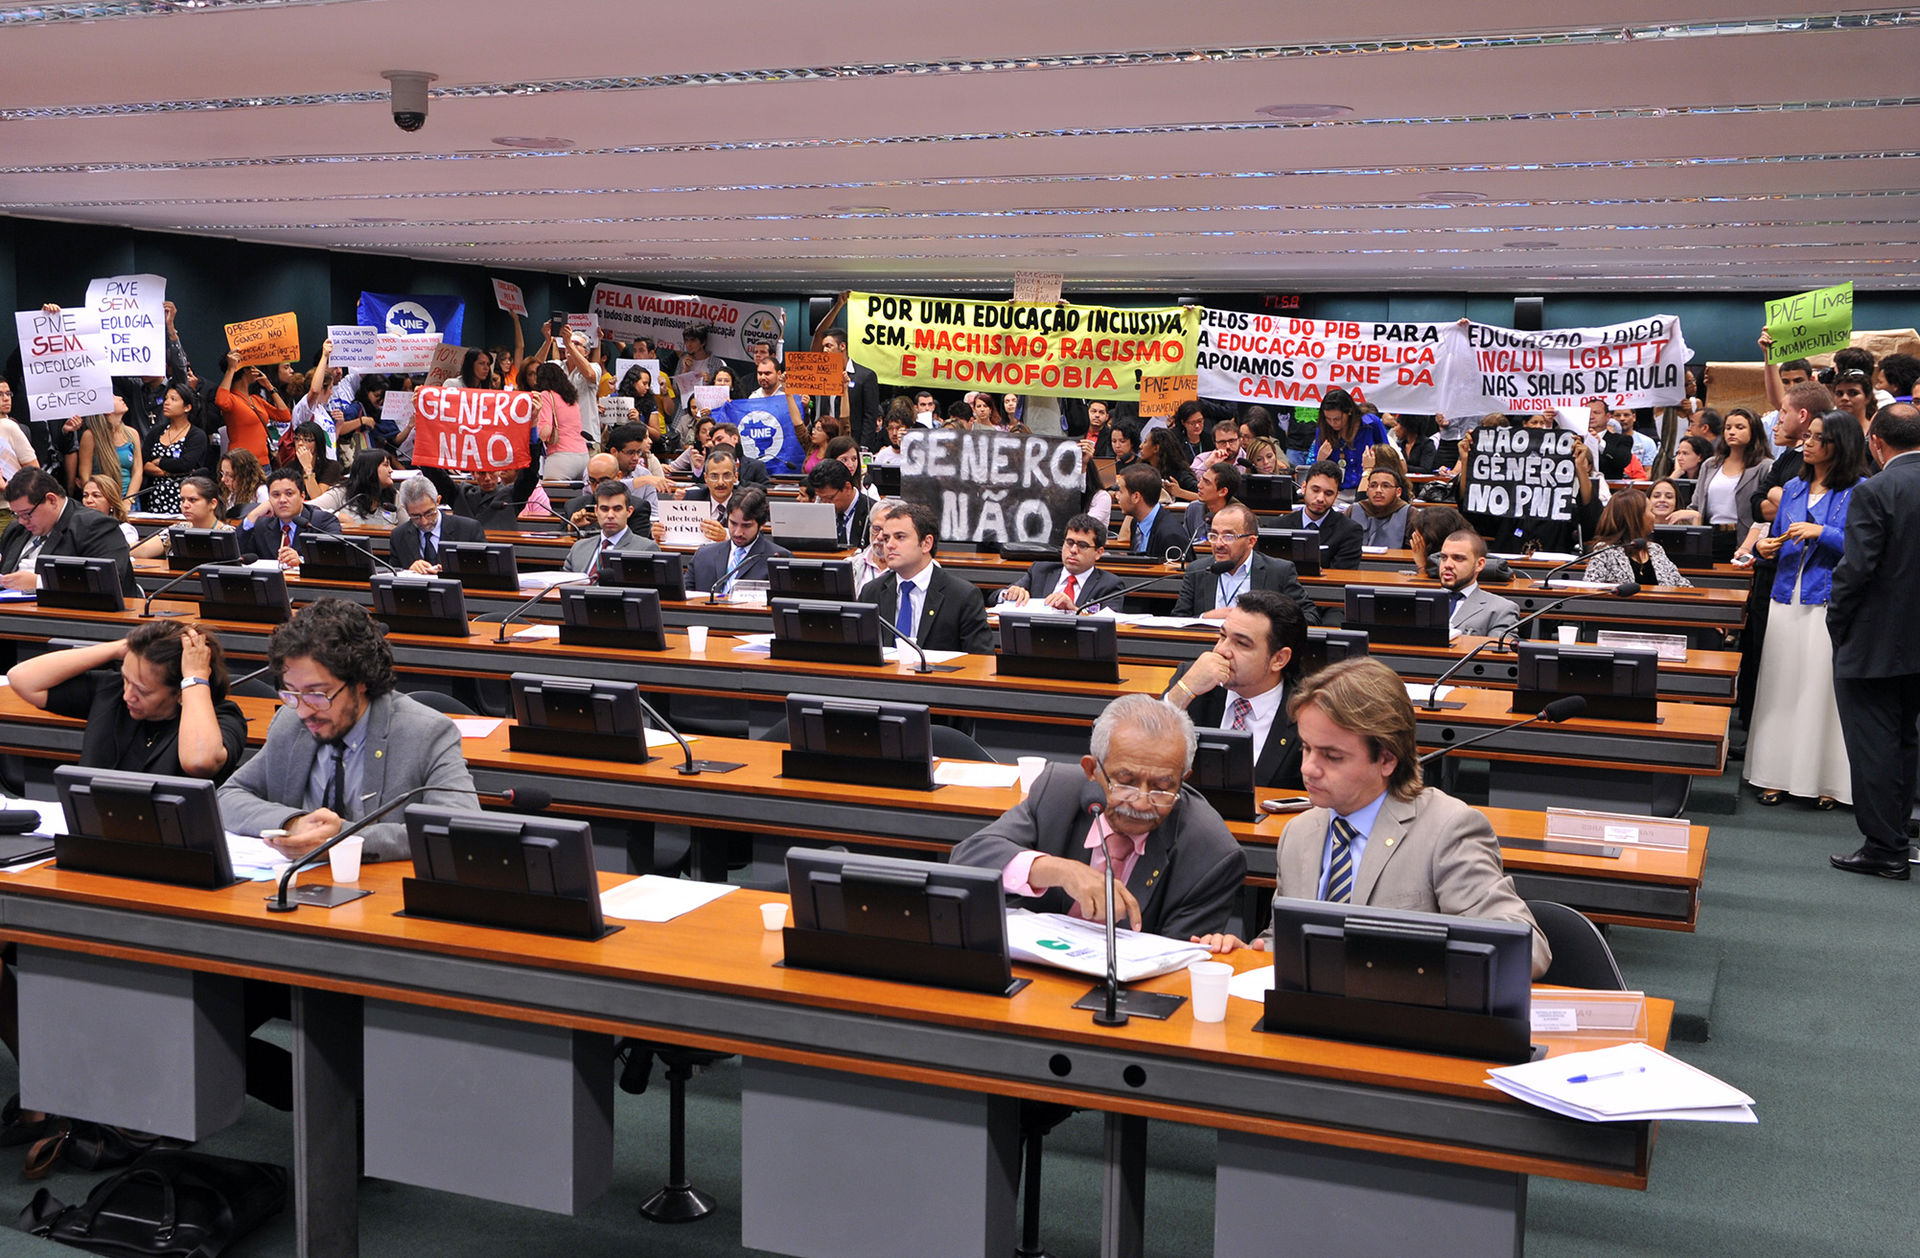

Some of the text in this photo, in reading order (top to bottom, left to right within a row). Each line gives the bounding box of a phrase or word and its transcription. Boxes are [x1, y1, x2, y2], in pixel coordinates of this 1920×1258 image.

[106, 281, 138, 296] PNE
[98, 297, 139, 313] SEM
[596, 289, 738, 326] PELA VALORIZAÇÃO
[868, 295, 1188, 337] POR UMA EDUCAÇÃO INCLUSIVA,
[1770, 296, 1807, 326] PNE
[33, 314, 77, 335] PNE
[101, 313, 154, 330] EOLOGIA
[401, 319, 424, 329] UNE
[743, 329, 778, 341] EDUCAÇÃO
[1198, 309, 1439, 343] PELOS 10% DO PIB PARA
[1601, 319, 1664, 345] LAICA
[1792, 325, 1807, 337] DO
[31, 333, 84, 356] SEM
[111, 333, 131, 344] DE
[861, 324, 1184, 363] SEM, MACHISMO, RACISMO
[1197, 330, 1435, 364] A EDUCAÇÃO PÚBLICA
[29, 354, 95, 375] IDEOLOGIA
[1196, 351, 1434, 387] APOIAMOS O PNE DA
[1476, 339, 1670, 373] INCLUI LGBTTT
[59, 375, 80, 388] DE
[901, 354, 918, 377] E
[932, 357, 1118, 390] HOMOFOBIA
[1144, 376, 1172, 393] PNE
[1481, 363, 1679, 398] NAS SALAS DE AULA
[35, 389, 97, 411] GÊNERO
[417, 386, 533, 426] GÊNERO
[750, 428, 772, 438] UNE
[1476, 425, 1576, 456] NÃO AO
[437, 425, 514, 470] NÃO
[1467, 483, 1573, 520] NO PNE
[940, 488, 1053, 544] NÃO
